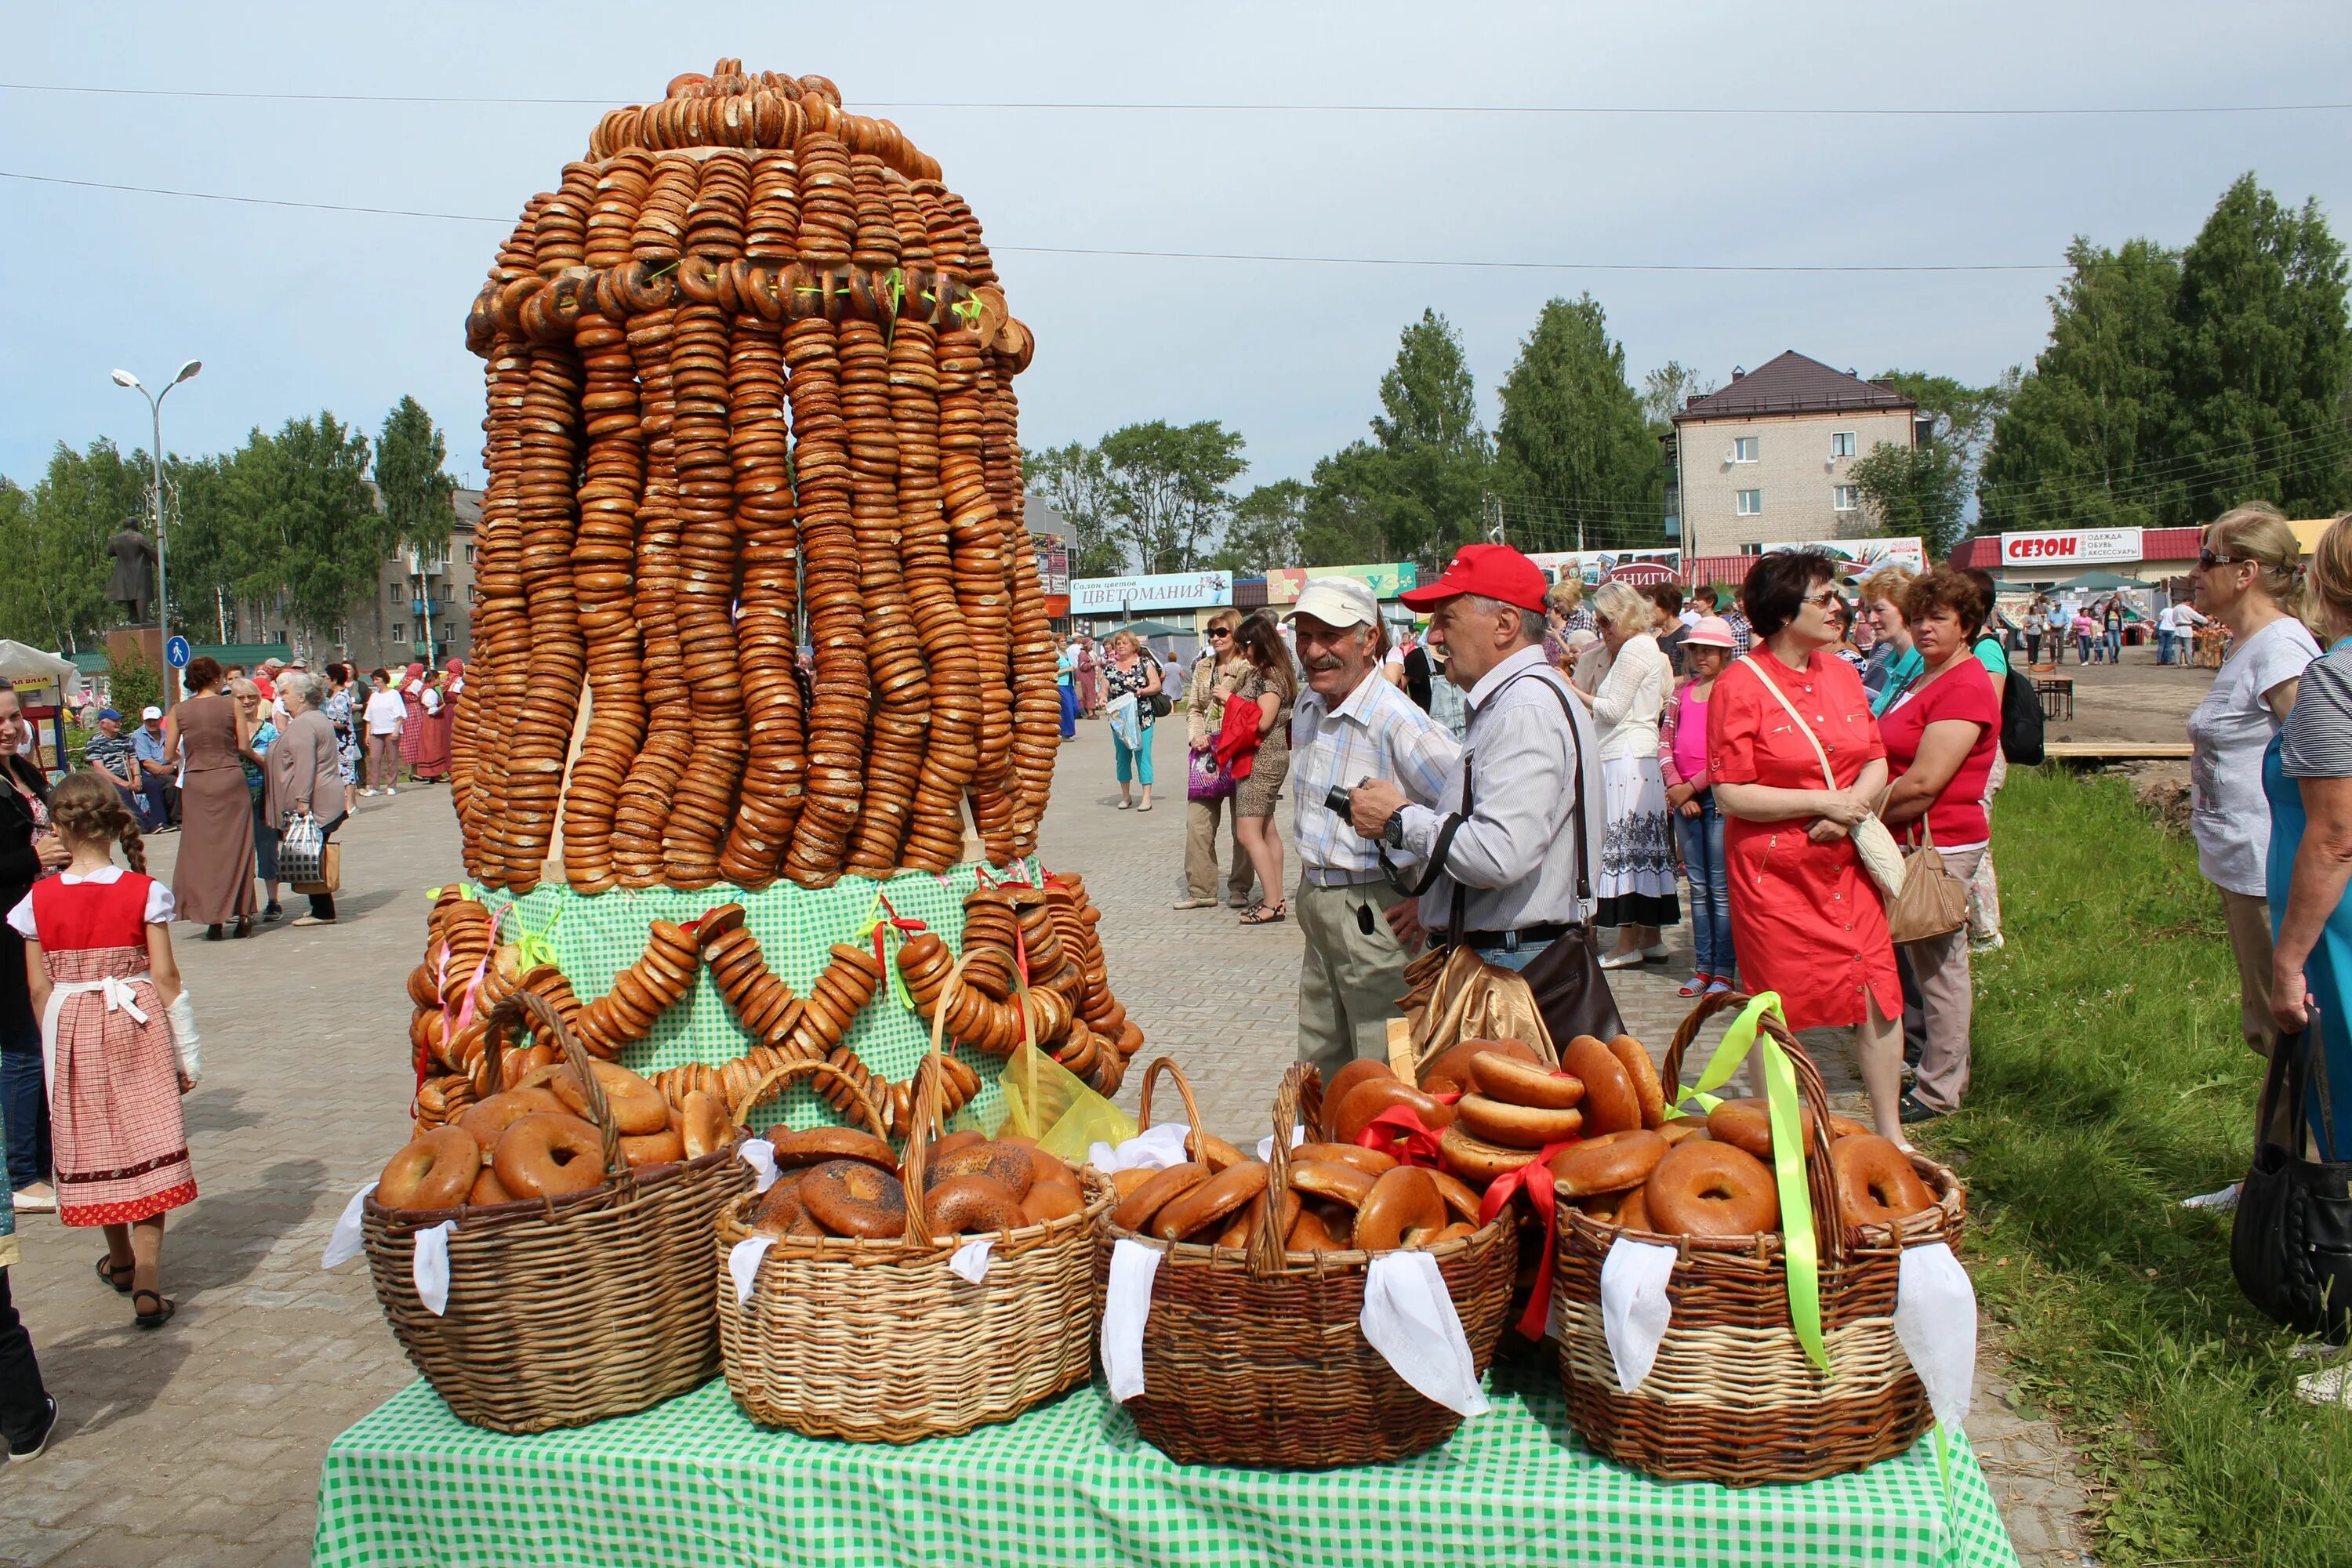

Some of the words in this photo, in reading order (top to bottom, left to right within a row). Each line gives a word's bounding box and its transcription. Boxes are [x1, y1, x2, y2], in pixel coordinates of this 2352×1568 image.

[2009, 537, 2077, 558] СЕЗОН
[1073, 582, 1102, 590] Салон
[1610, 572, 1672, 586] КНИГИ
[1082, 584, 1204, 606] ЦВЕТОМАНИЯ
